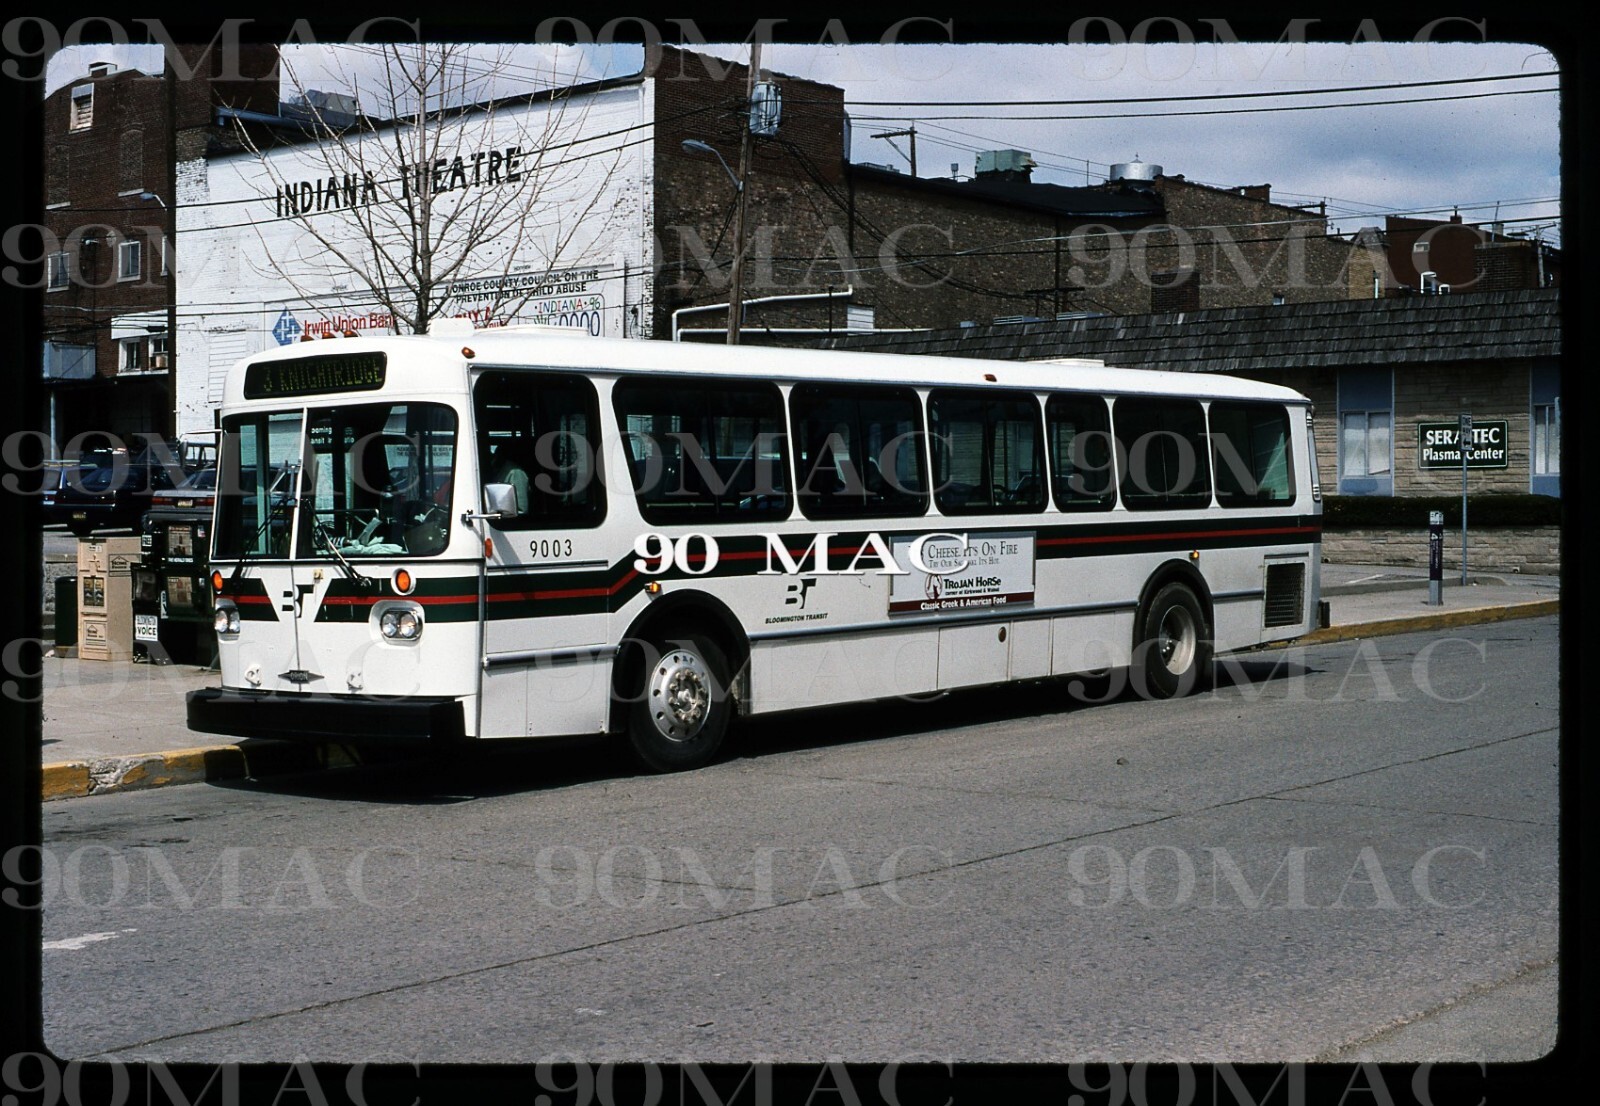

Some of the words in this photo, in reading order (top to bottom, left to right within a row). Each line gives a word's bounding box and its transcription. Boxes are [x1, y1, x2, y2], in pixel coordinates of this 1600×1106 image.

[276, 170, 378, 217] INDIANA
[484, 277, 519, 291] COUNTY
[564, 270, 578, 281] ON
[581, 269, 599, 281] THE
[556, 282, 587, 295] ABUSE
[304, 317, 331, 335] Irwin
[333, 314, 367, 333] Union
[369, 312, 396, 329] Ban
[1423, 448, 1461, 462] Plasma
[1465, 447, 1504, 461] Center
[529, 538, 573, 559] 9003
[981, 541, 997, 556] ON
[1000, 541, 1018, 555] FIRE
[920, 602, 940, 611] Classic
[941, 600, 958, 609] Greek
[966, 597, 992, 607] American
[993, 596, 1007, 604] Food
[765, 614, 805, 625] BLOOMINGTON
[805, 612, 829, 622] TRANSIT
[137, 626, 156, 636] VOICE
